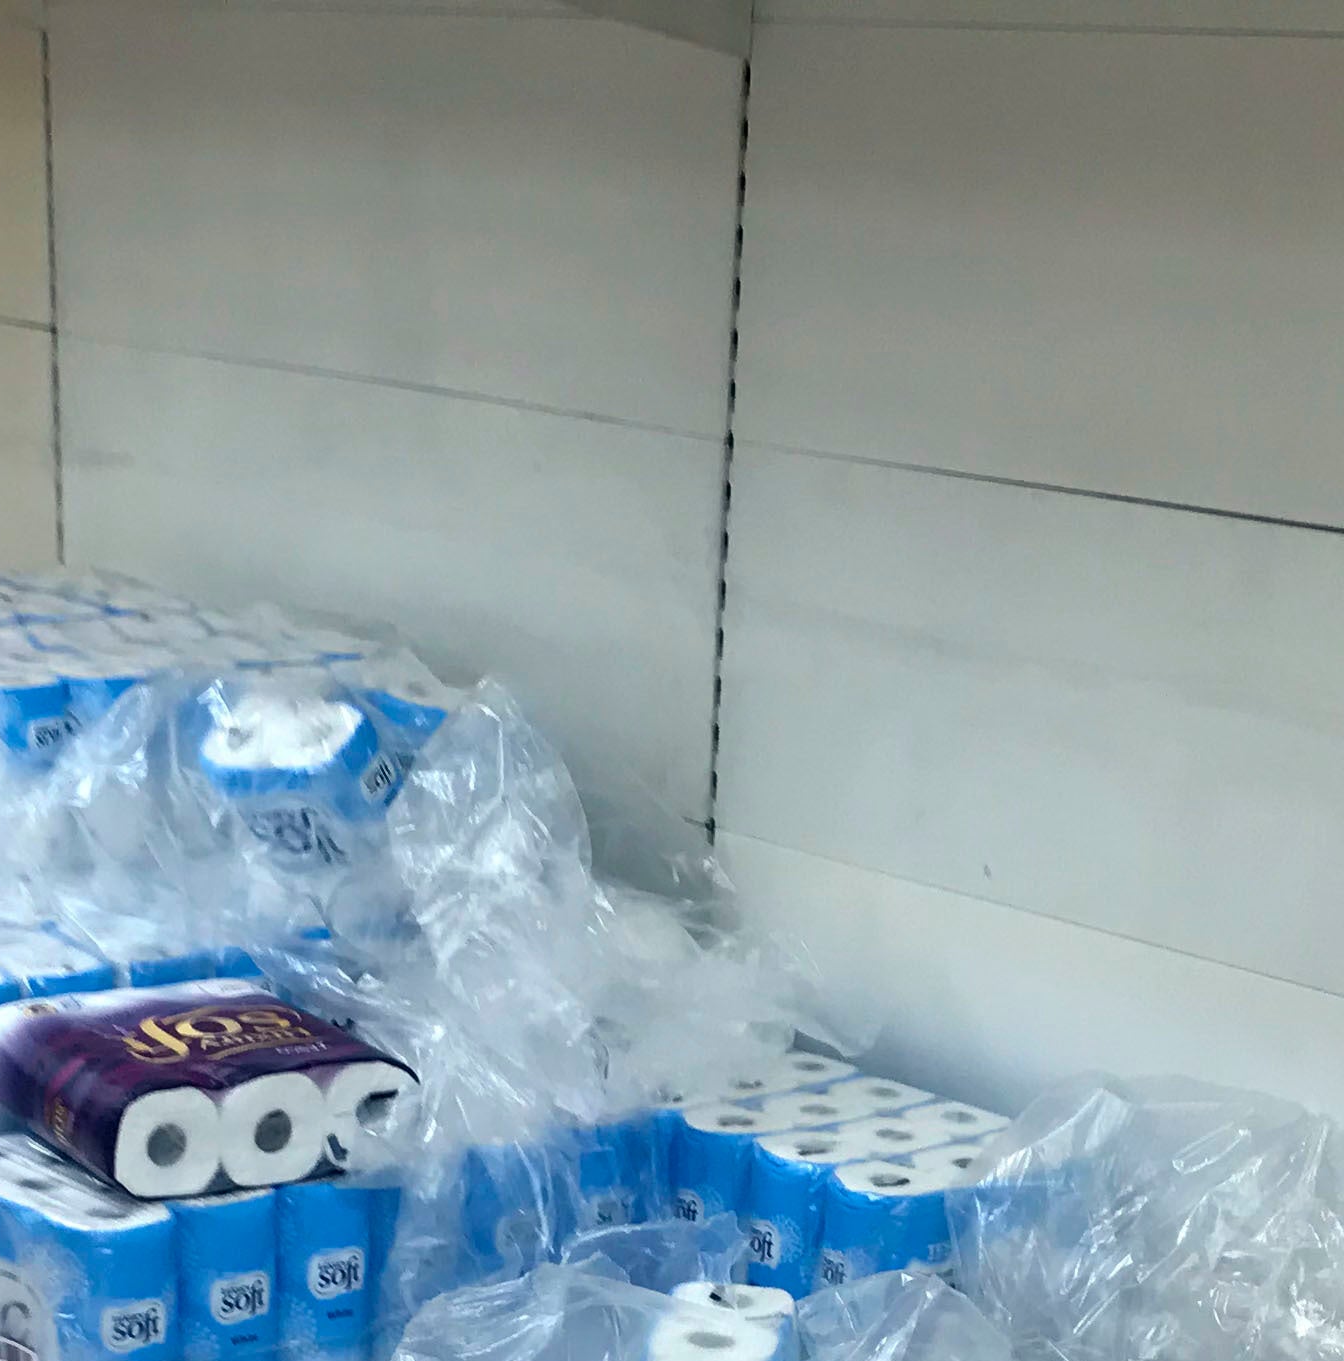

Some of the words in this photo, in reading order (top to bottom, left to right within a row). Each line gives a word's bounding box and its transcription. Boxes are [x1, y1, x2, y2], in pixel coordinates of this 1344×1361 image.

[318, 1255, 359, 1289] soft
[221, 1280, 264, 1313] soft
[112, 1307, 159, 1343] soft
